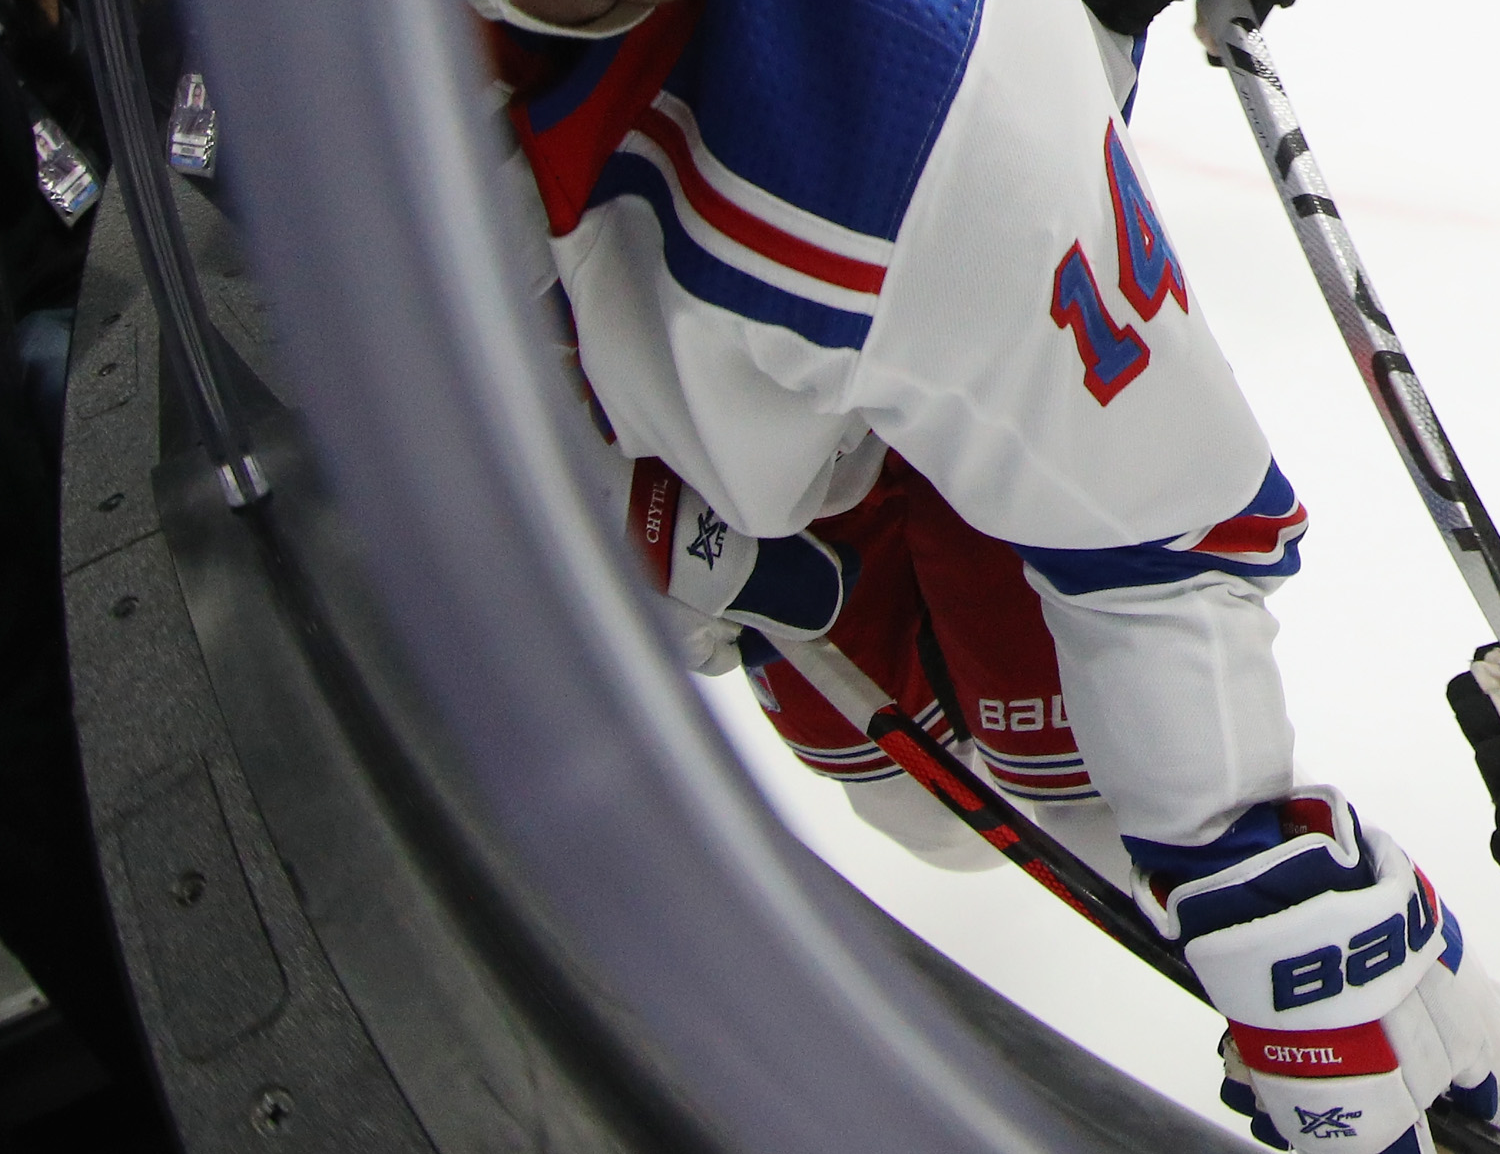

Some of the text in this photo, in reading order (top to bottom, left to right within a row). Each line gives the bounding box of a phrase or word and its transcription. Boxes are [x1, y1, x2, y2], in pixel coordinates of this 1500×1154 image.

[1050, 116, 1189, 408] 14
[646, 479, 668, 544] CHYTIL
[1263, 1043, 1343, 1066] CHYTIL
[1313, 1126, 1358, 1140] LITE
